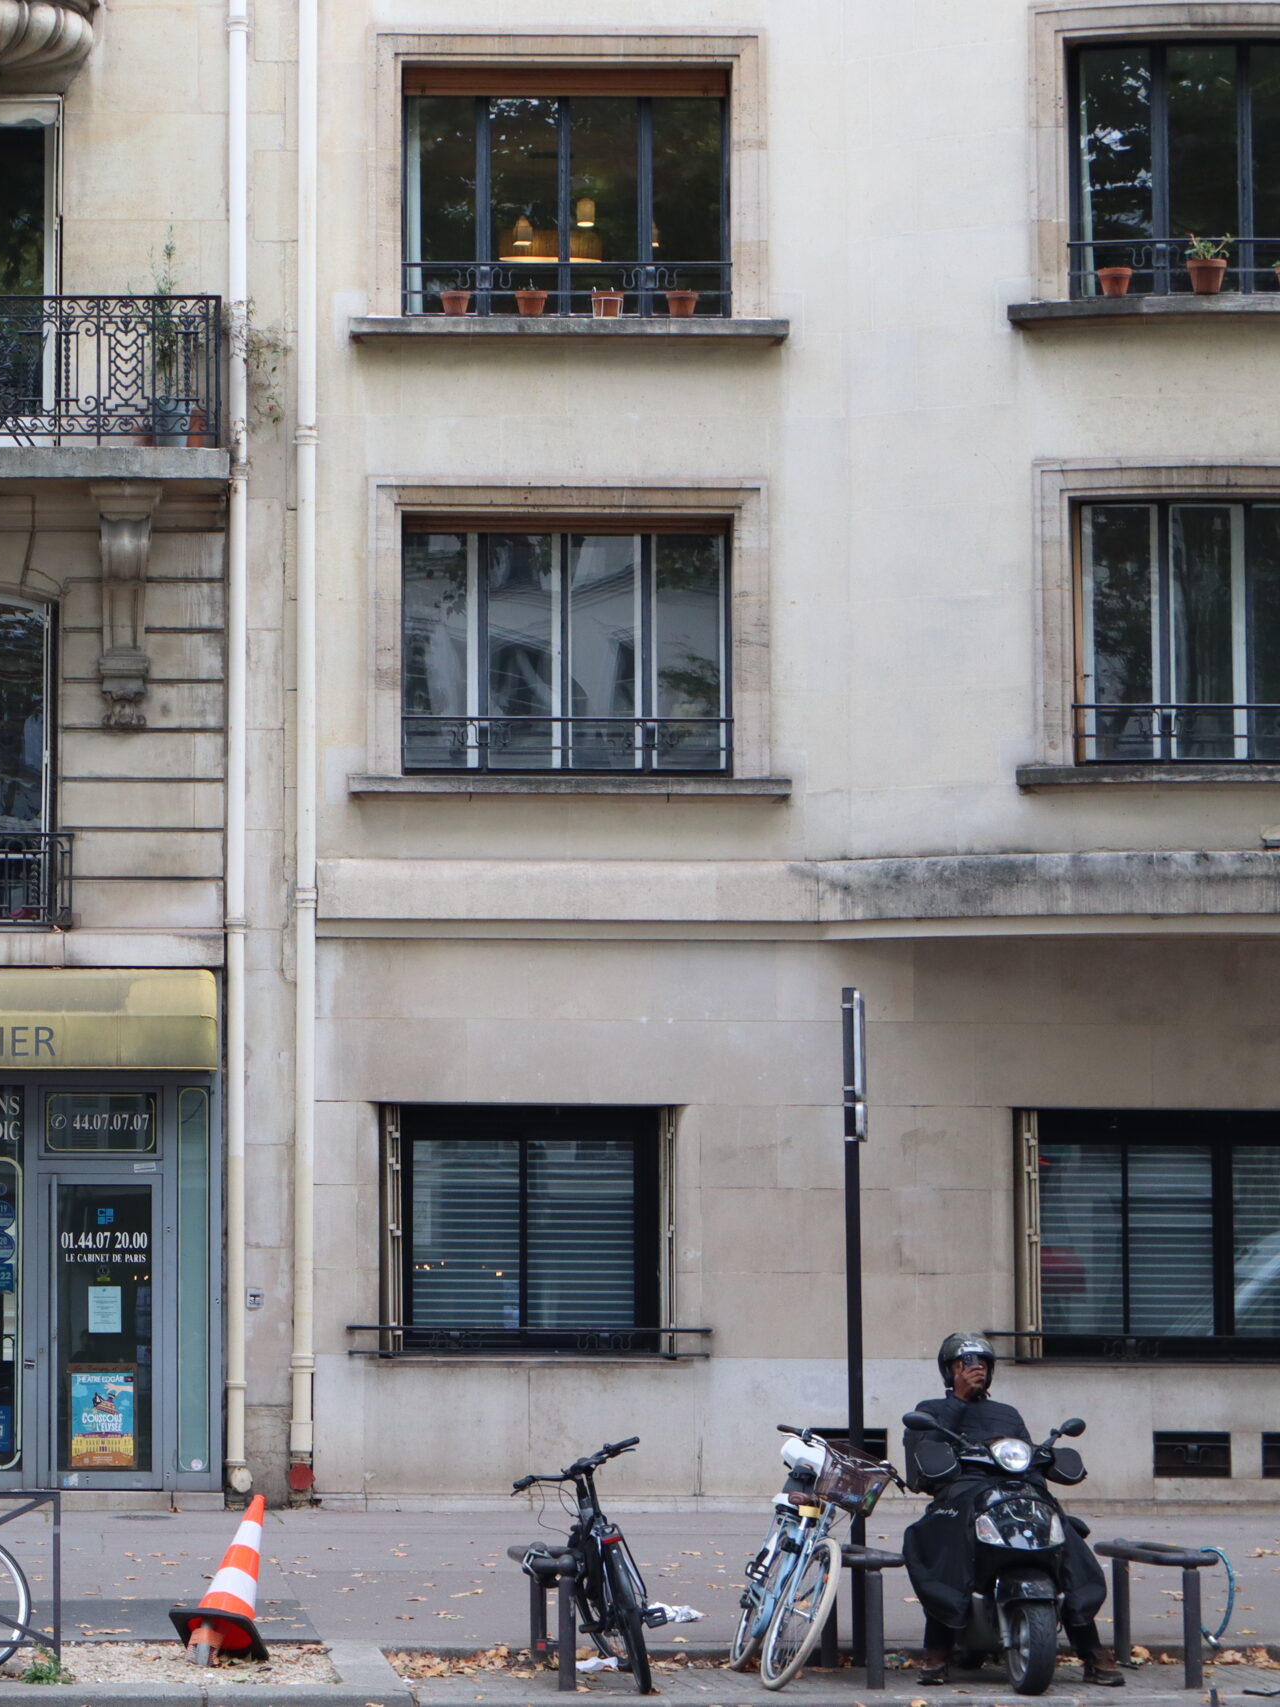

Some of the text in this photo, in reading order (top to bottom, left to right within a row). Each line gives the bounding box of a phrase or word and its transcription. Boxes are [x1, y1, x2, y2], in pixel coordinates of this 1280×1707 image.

[72, 1113, 150, 1130] 44.07.07.07
[60, 1231, 148, 1249] 01.44.07 20.00
[65, 1253, 147, 1263] LE CABINET DE PARIS
[82, 1412, 123, 1424] COUSCOUS
